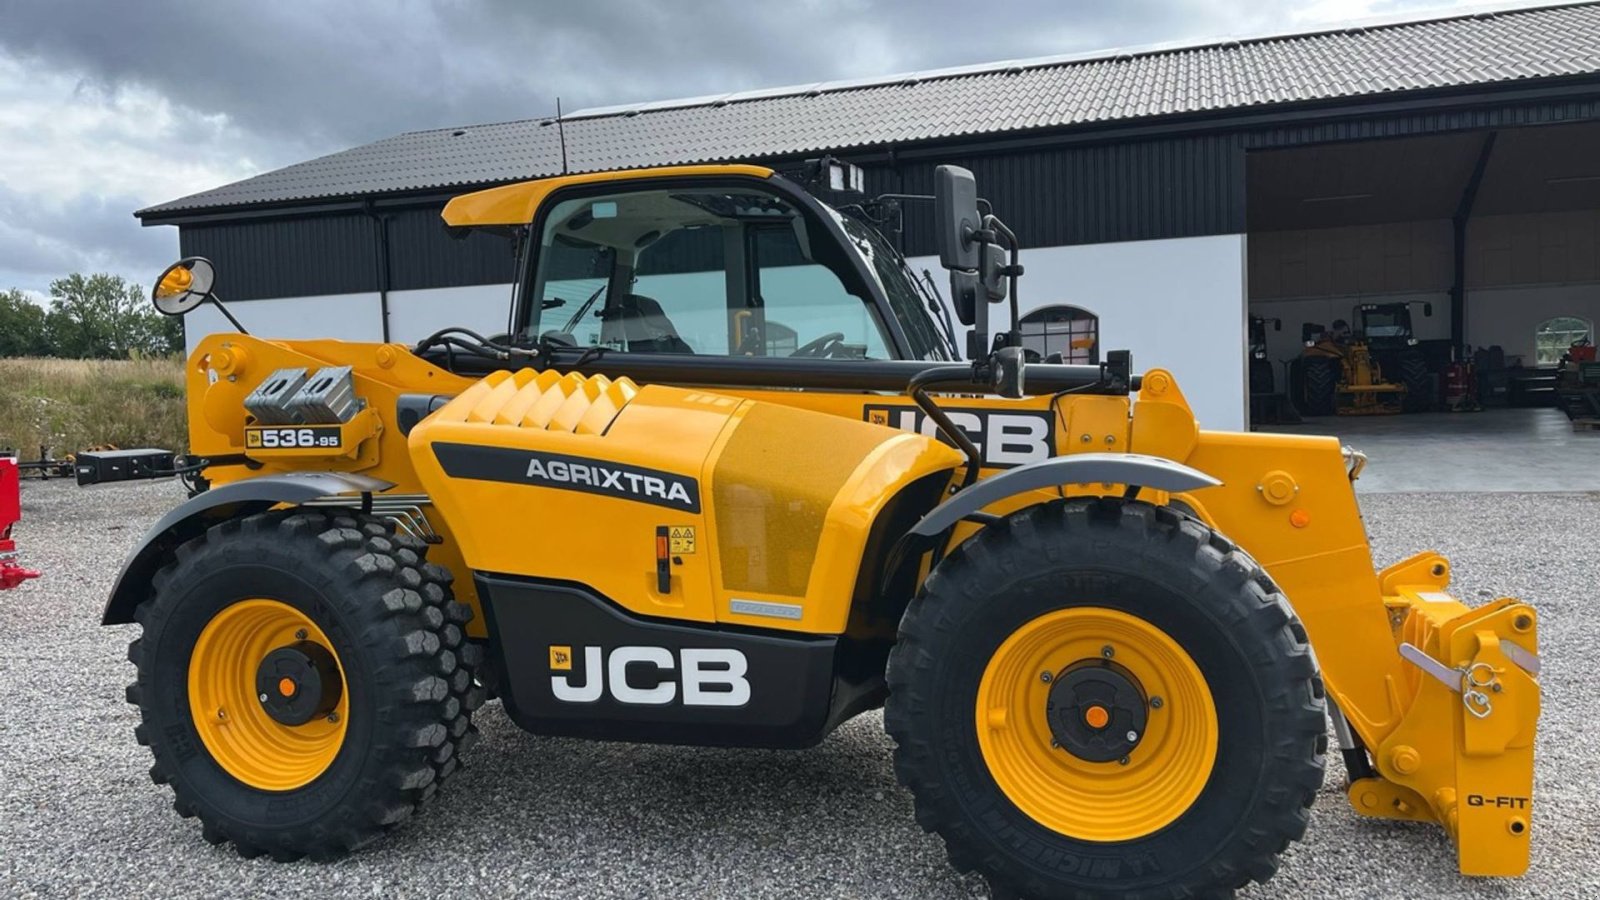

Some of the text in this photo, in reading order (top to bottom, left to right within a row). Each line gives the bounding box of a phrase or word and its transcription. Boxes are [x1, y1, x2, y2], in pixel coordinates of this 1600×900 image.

[527, 458, 692, 505] AGRIXTRA
[551, 646, 751, 706] JCB
[1467, 794, 1529, 809] Q-FIT
[980, 808, 1121, 878] MICHELIN
